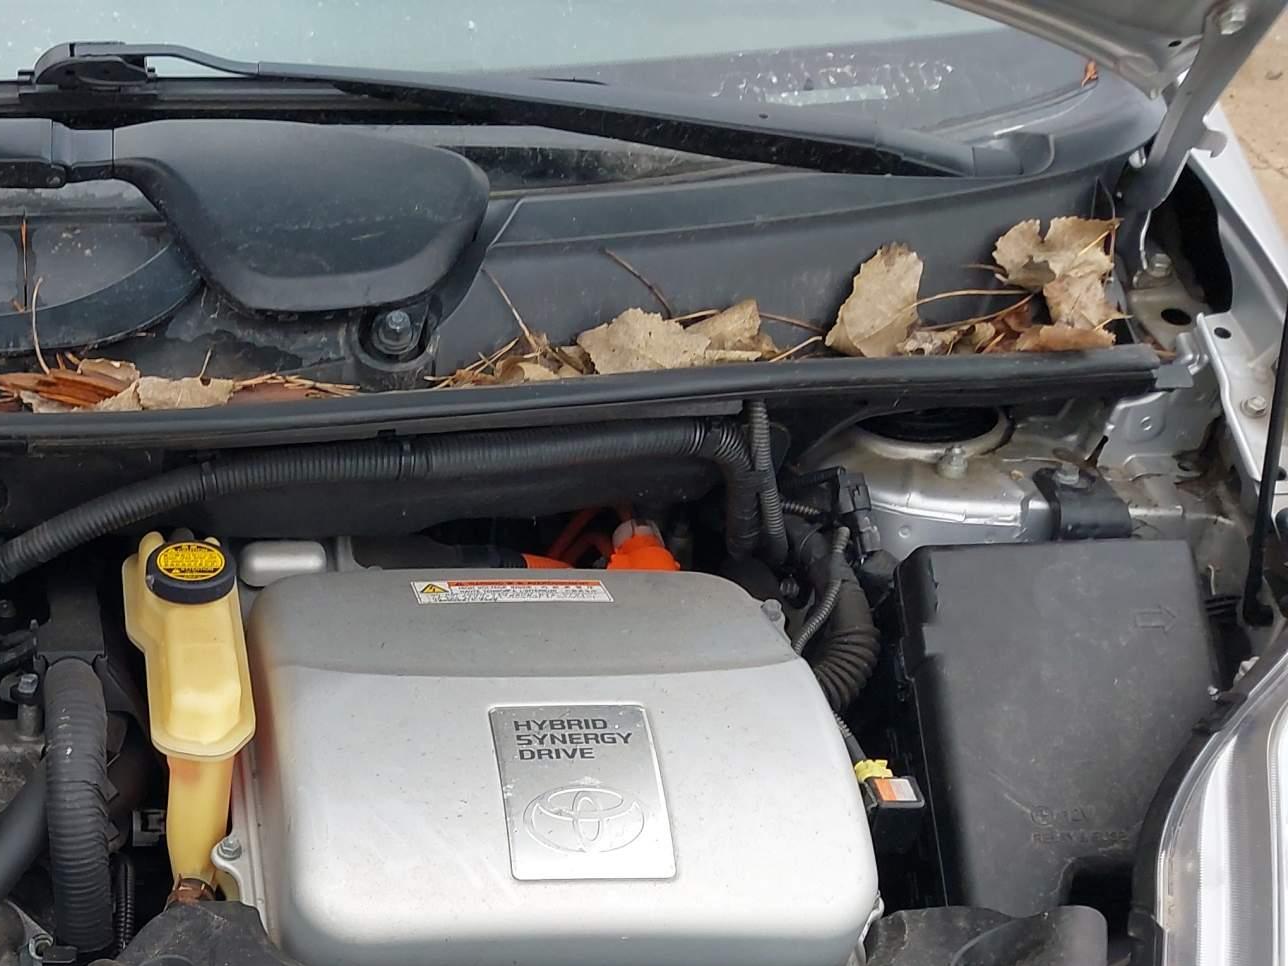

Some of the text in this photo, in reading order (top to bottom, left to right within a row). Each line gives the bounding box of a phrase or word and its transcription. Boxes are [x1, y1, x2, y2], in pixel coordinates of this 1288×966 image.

[513, 718, 608, 731] HYBRID
[516, 732, 633, 746] SYNERGY
[518, 747, 595, 761] DRIVE
